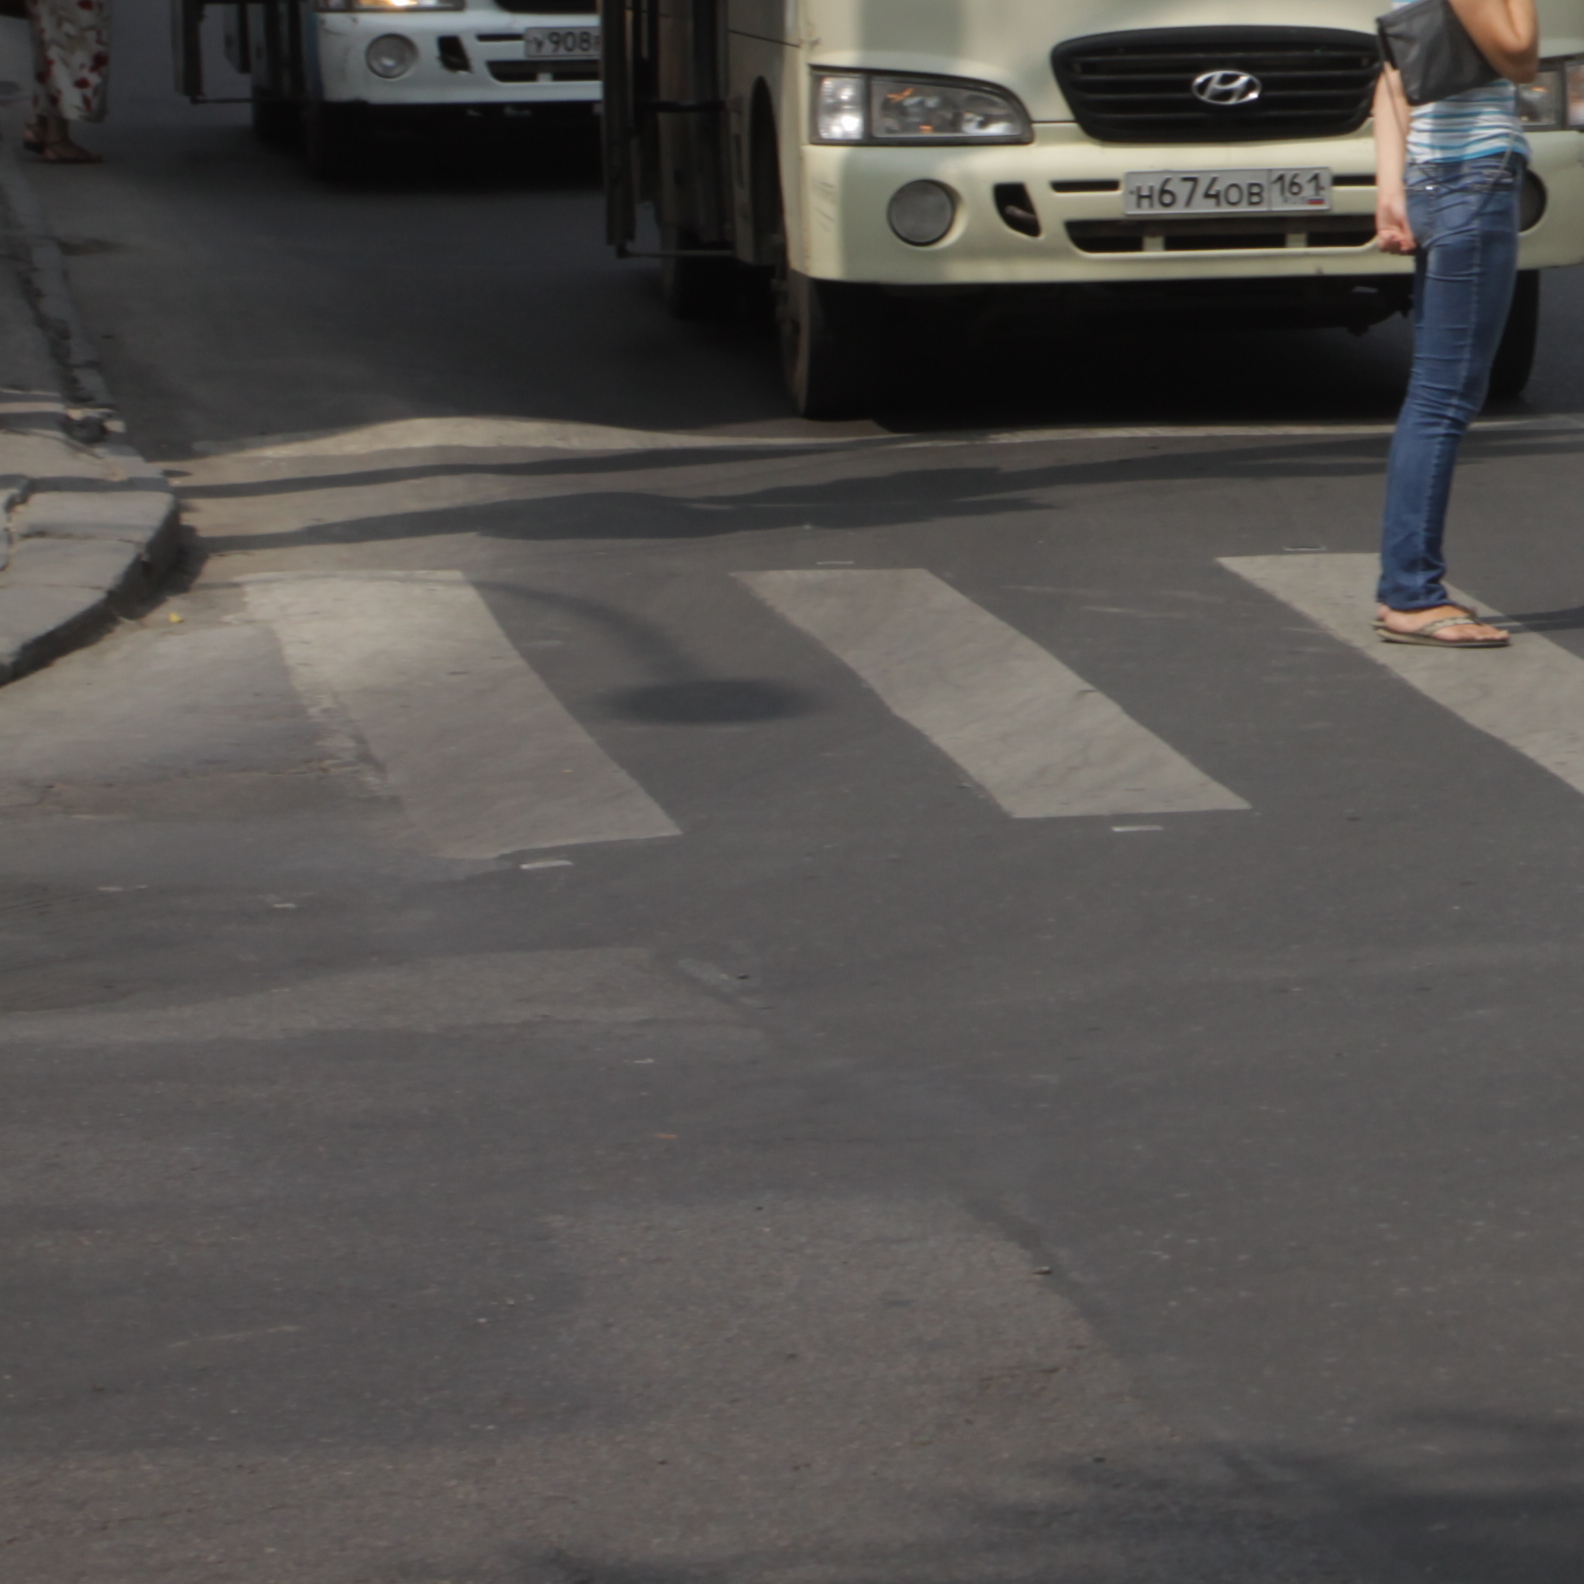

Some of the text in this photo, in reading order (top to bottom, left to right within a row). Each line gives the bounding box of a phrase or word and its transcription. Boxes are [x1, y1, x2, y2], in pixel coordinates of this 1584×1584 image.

[533, 30, 600, 53] У908
[1135, 172, 1322, 209] Н674ОВ 161
